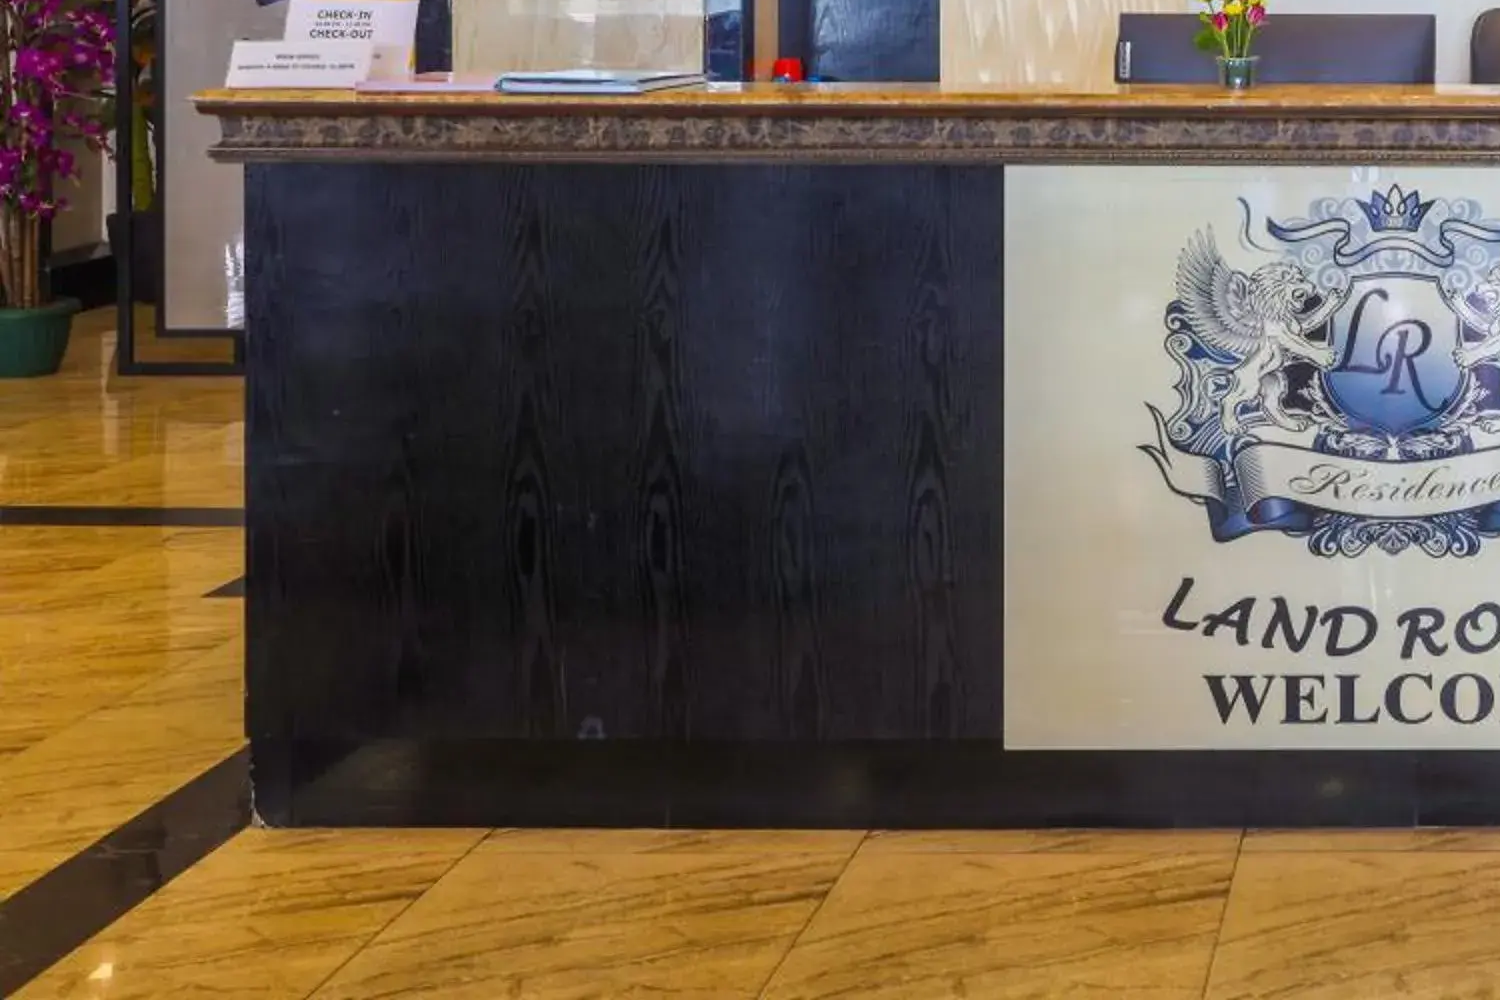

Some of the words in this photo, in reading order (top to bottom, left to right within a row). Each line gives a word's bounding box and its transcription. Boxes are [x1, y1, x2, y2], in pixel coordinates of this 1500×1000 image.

[317, 9, 373, 20] CHECK-IN
[309, 29, 374, 39] CHECK-OUT
[1162, 577, 1378, 657] LAND
